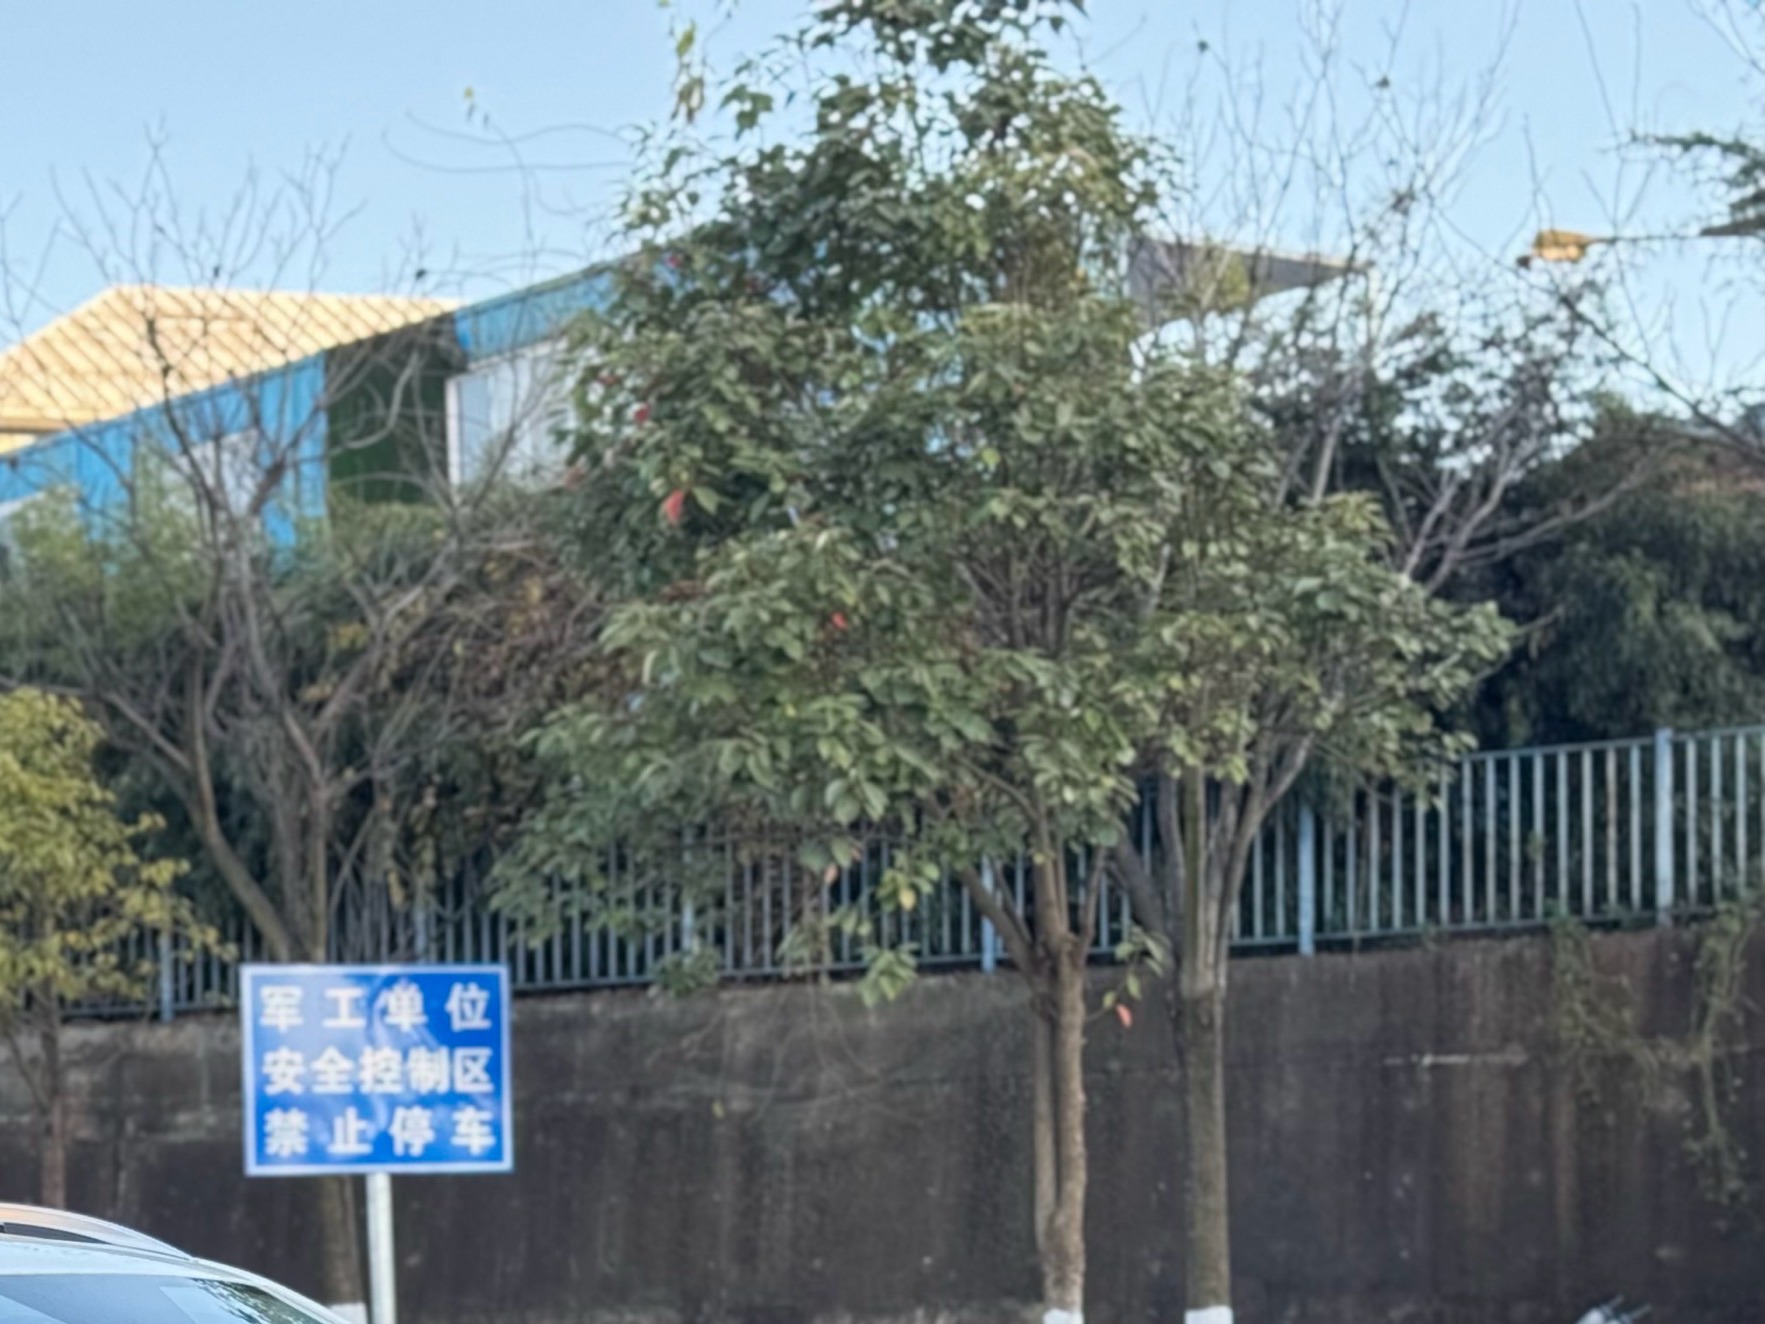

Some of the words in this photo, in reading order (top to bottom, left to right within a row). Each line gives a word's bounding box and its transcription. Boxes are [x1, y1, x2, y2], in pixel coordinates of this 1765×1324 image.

[260, 979, 491, 1032] 军工单位
[262, 1045, 493, 1095] 安全控制区
[264, 1105, 496, 1156] 禁止停车
